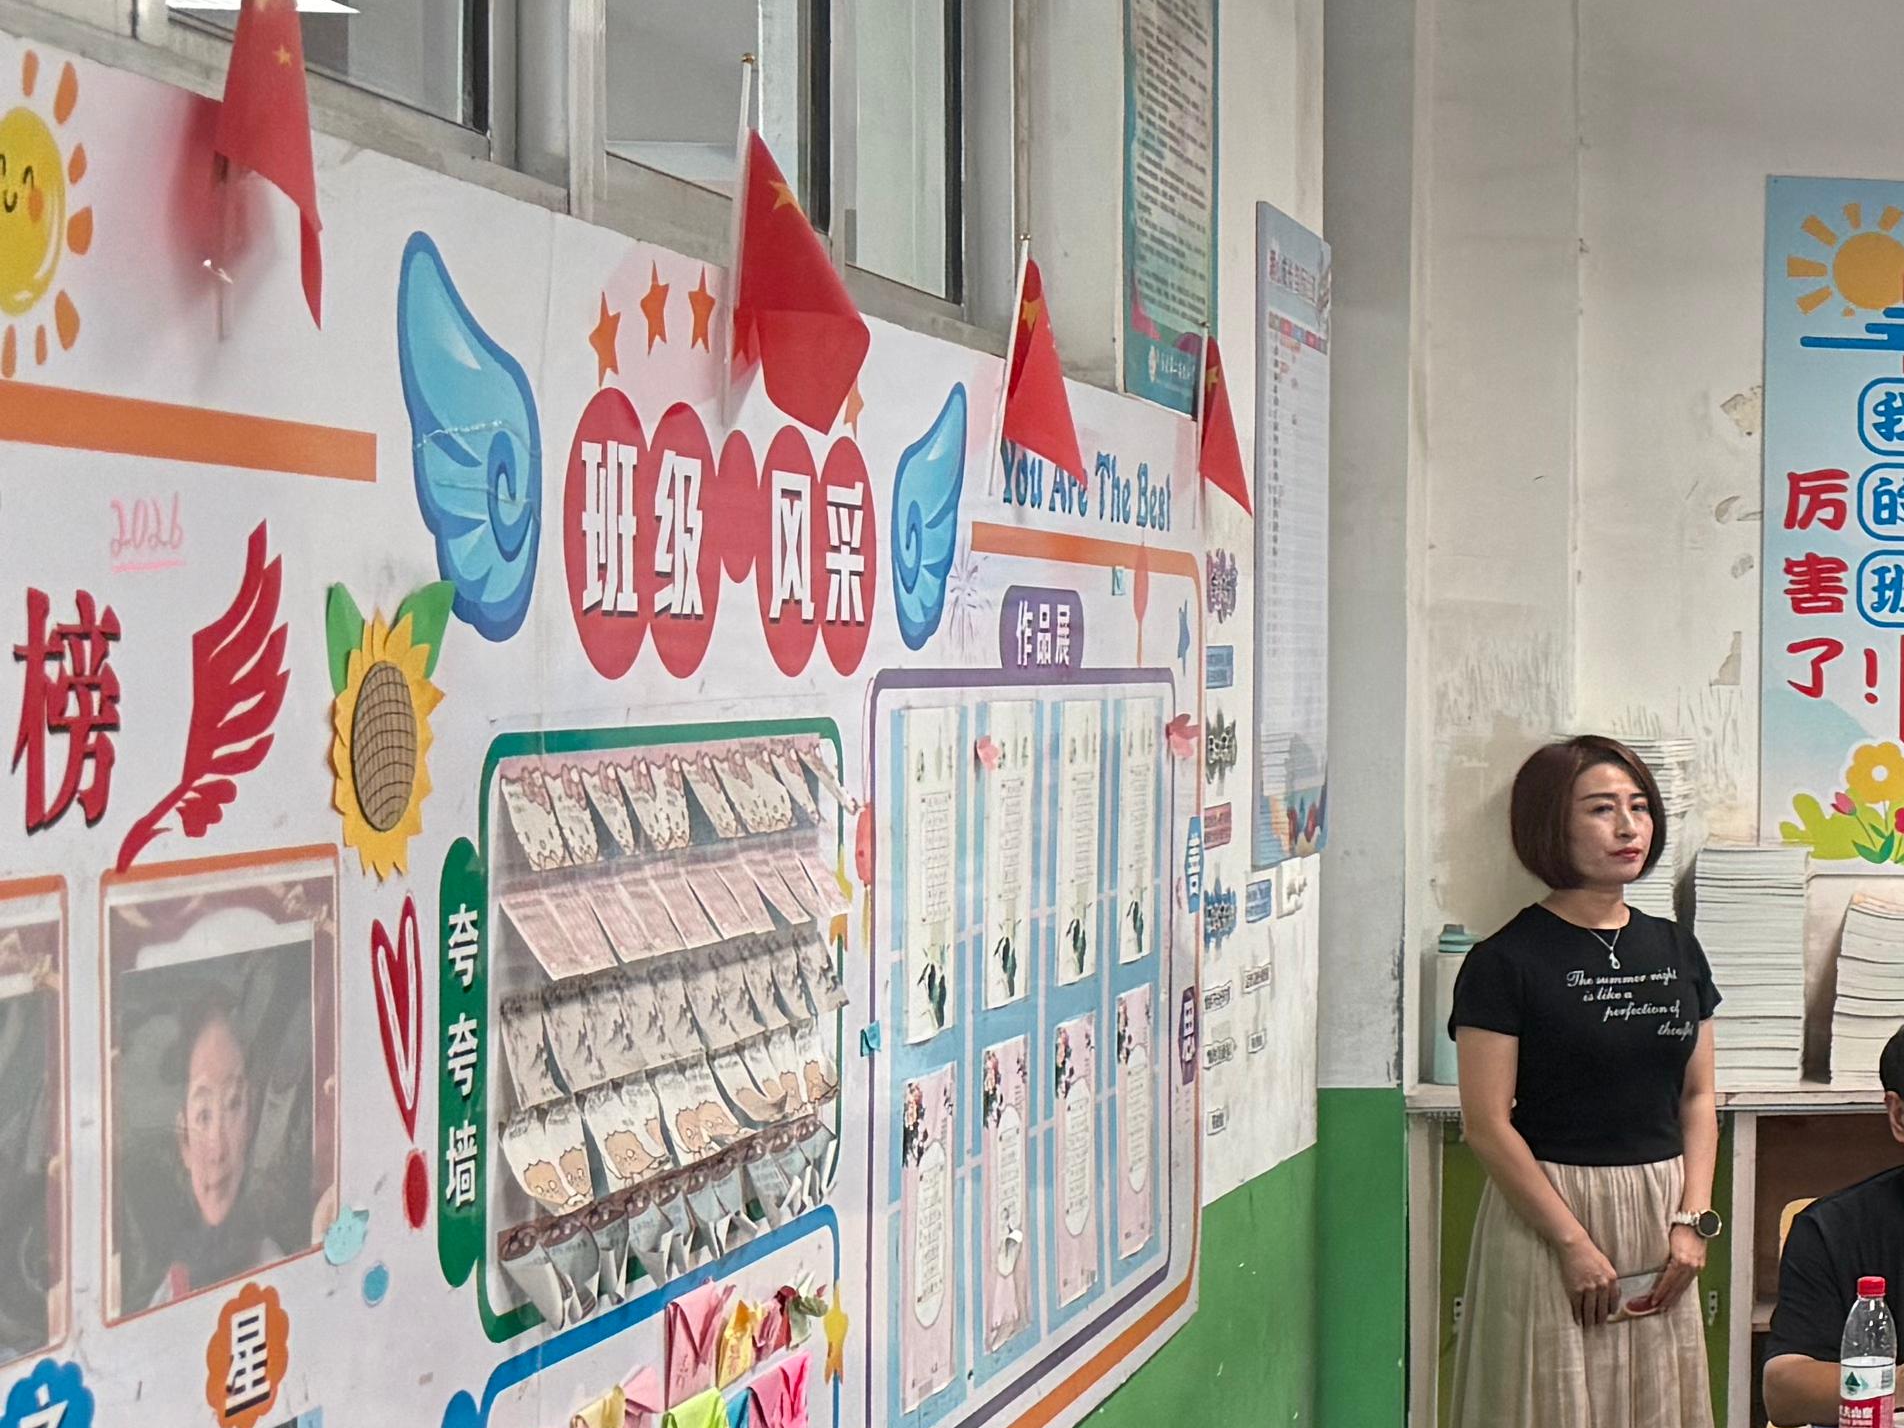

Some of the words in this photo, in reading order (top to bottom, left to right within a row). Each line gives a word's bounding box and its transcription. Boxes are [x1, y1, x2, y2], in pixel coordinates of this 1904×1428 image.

[110, 492, 186, 554] 2026
[1095, 450, 1132, 525] The
[1136, 461, 1172, 533] Best
[580, 440, 868, 625] 班级风采
[1016, 600, 1071, 668] 作品展
[12, 587, 123, 834] 榜
[1566, 970, 1594, 987] The
[1583, 990, 1595, 1002] is
[1597, 986, 1622, 1000] like
[1624, 991, 1633, 999] a
[444, 903, 480, 1210] 夸夸墙
